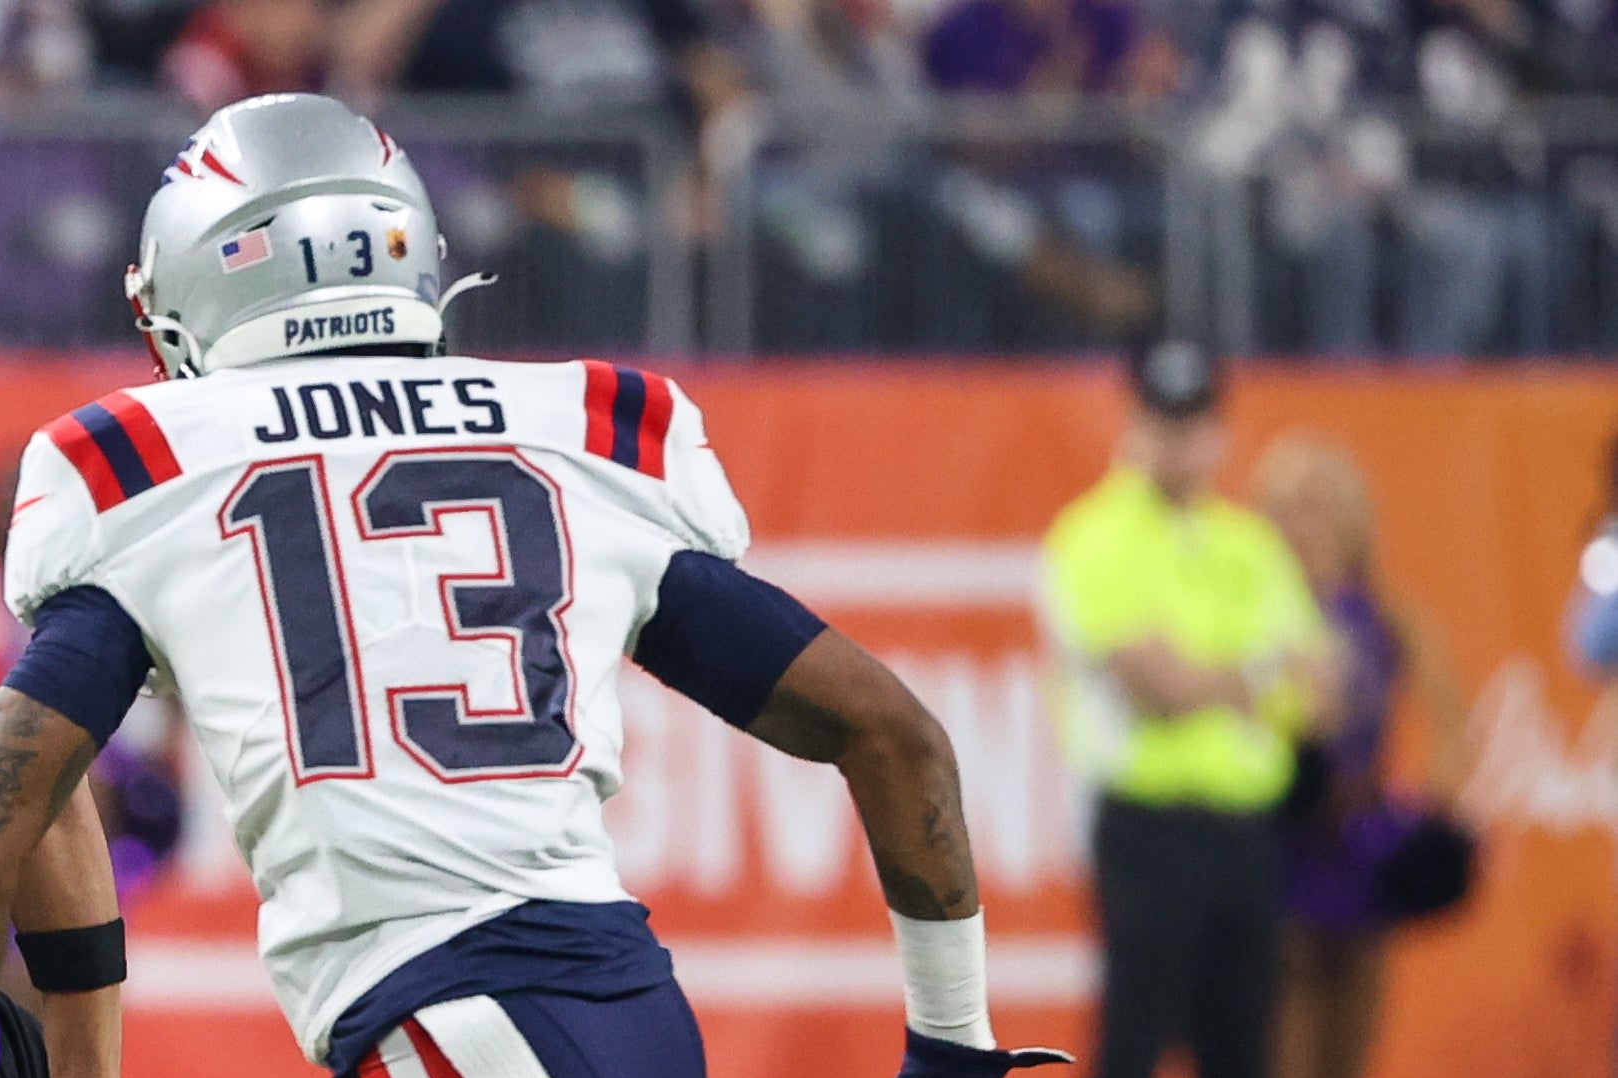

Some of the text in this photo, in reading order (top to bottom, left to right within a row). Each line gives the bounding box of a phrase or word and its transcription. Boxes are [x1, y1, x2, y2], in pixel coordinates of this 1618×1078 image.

[284, 307, 395, 347] PATRIOTS
[254, 377, 507, 443] JONES
[217, 445, 585, 788] 13
